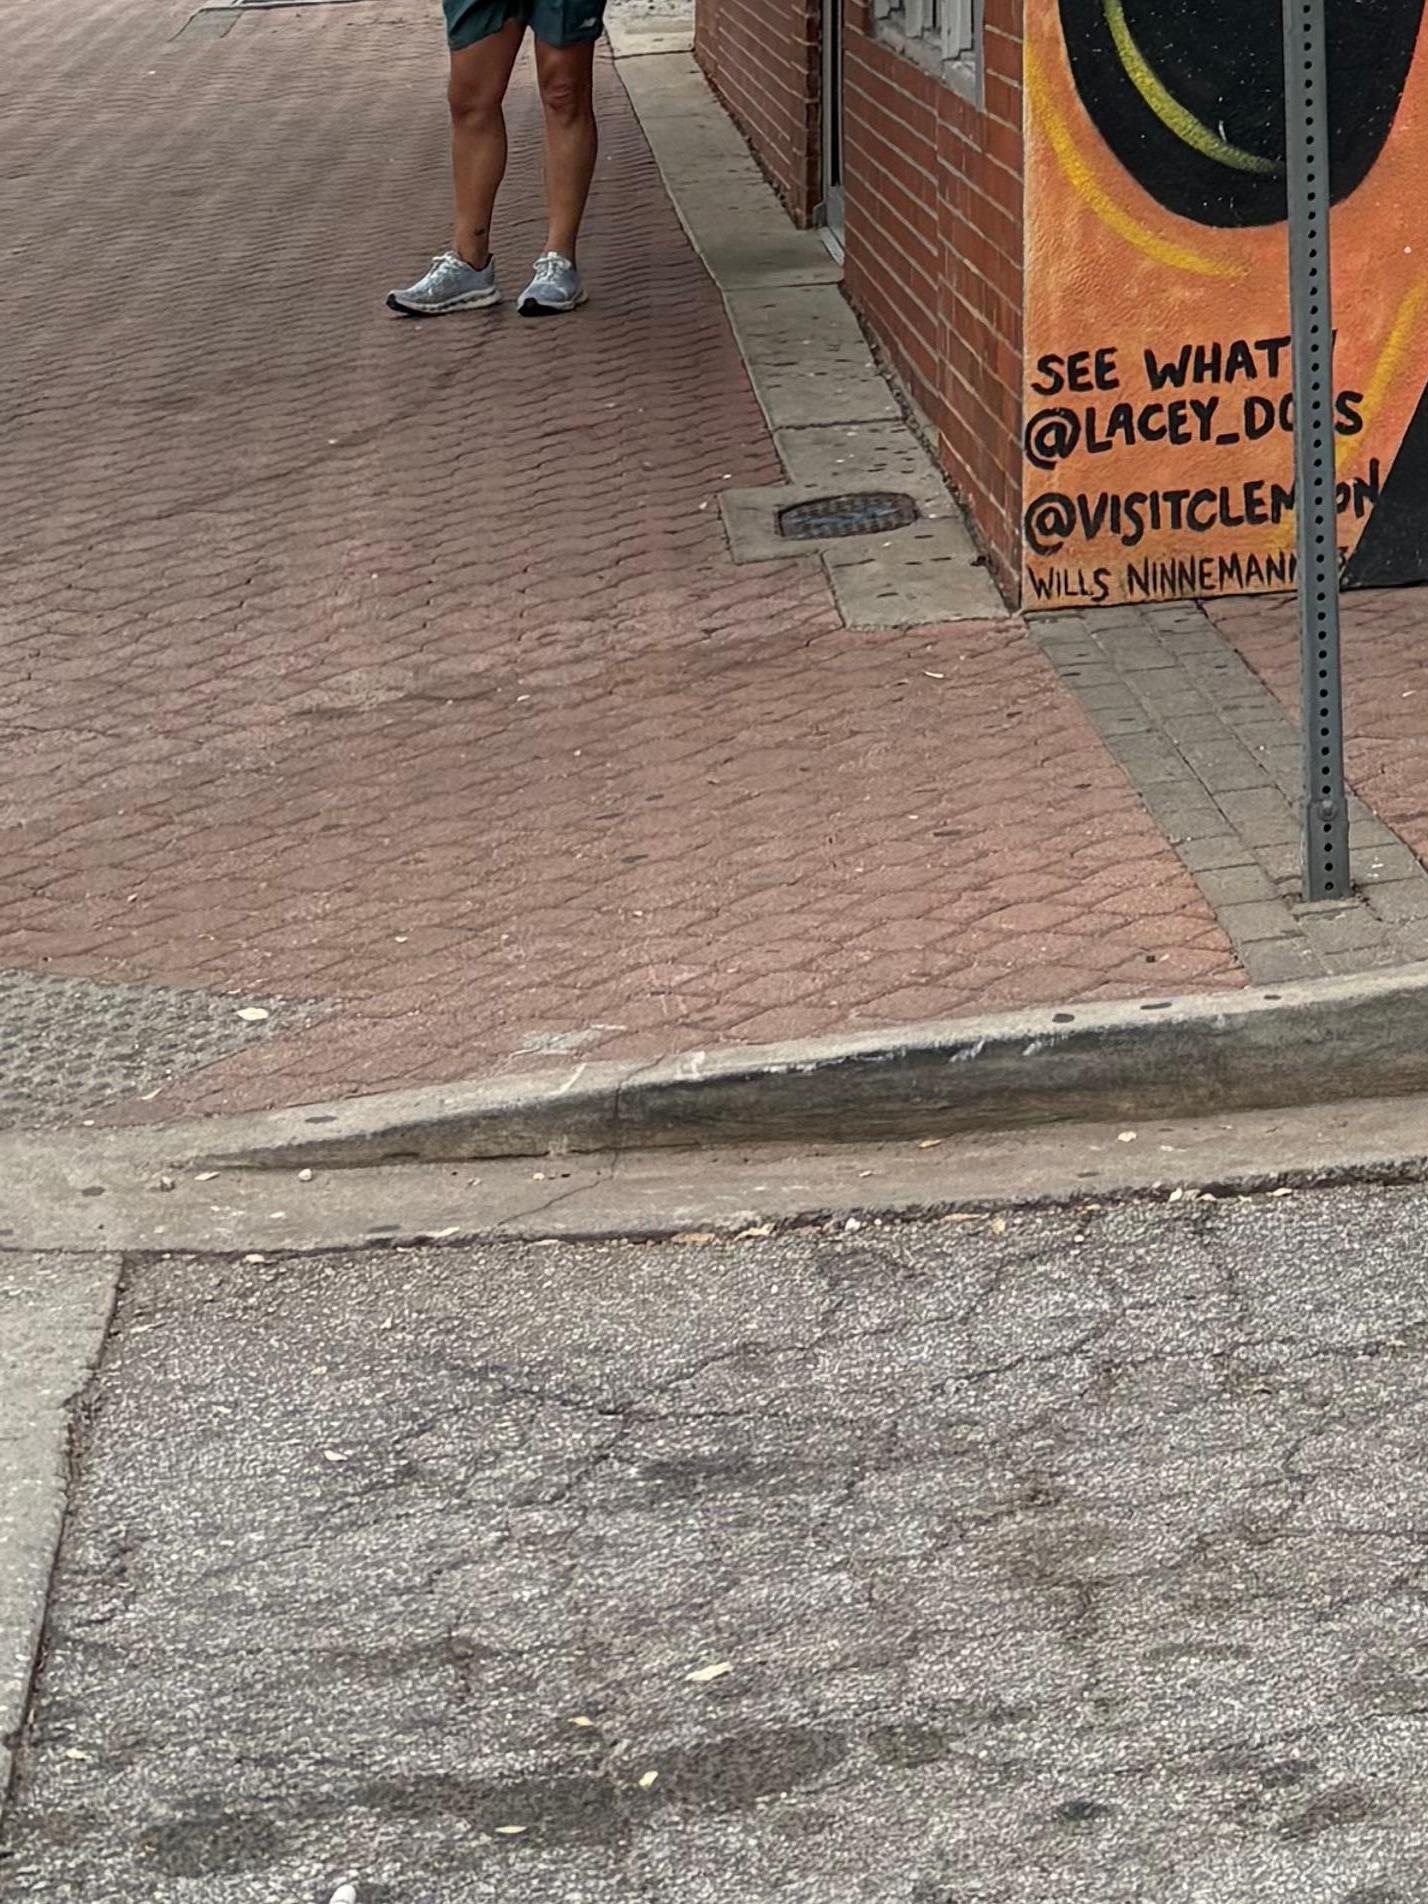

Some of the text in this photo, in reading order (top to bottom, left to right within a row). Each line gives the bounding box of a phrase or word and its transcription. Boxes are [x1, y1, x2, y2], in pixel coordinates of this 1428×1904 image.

[1031, 346, 1120, 396] SEE
[1024, 457, 1380, 556] @VISITCLEMON
[1027, 564, 1111, 602] WILLS
